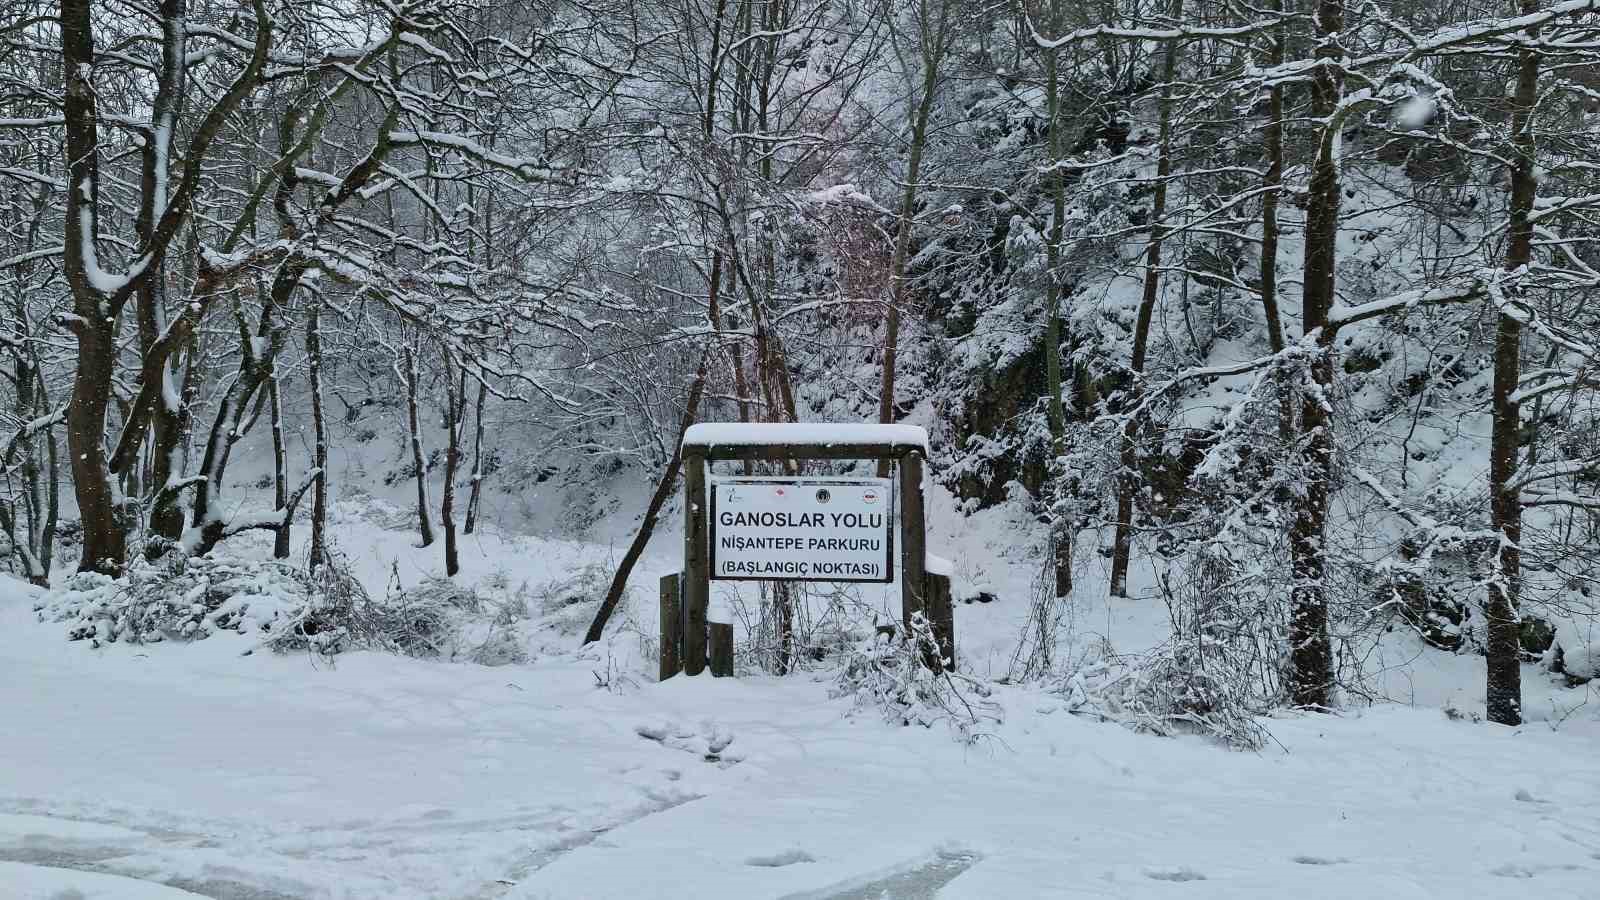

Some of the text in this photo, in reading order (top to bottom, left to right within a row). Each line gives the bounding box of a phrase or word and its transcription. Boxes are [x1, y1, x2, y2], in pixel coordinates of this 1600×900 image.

[720, 511, 882, 528] GANOSLAR YOLU
[722, 534, 880, 552] NİŞANTEPE PARKURU
[722, 560, 880, 579] (BAŞLANGIÇ NOKTASI)
